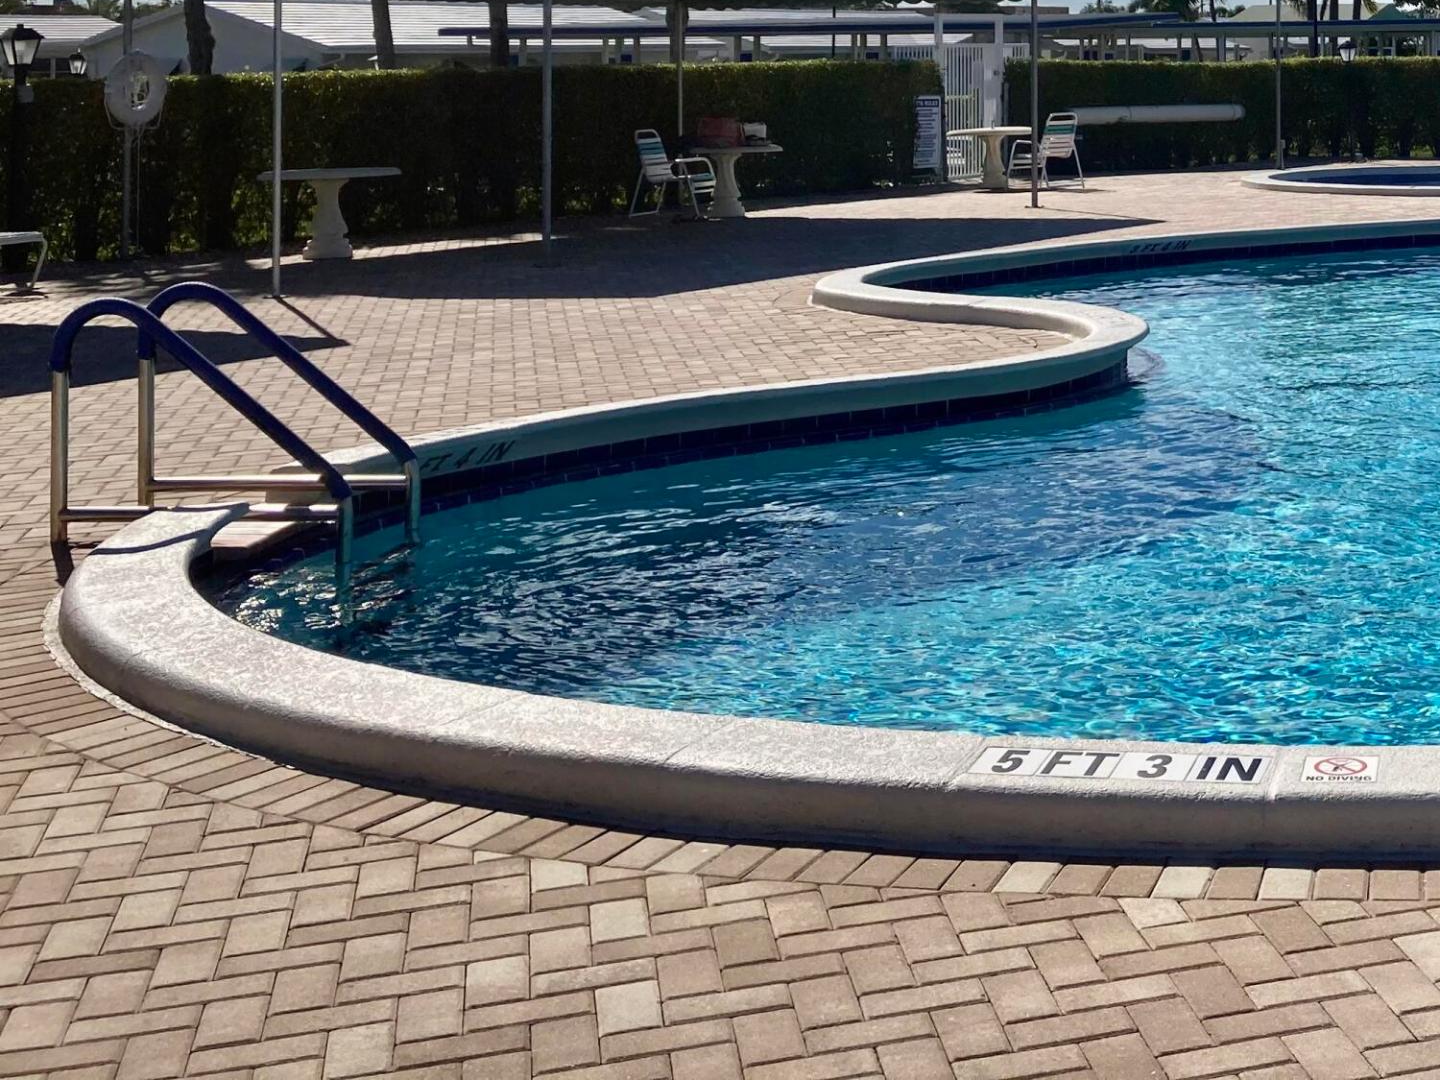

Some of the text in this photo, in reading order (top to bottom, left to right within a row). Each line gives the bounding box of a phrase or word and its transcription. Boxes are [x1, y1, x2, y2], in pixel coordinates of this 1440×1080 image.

[420, 453, 453, 471] FT
[477, 440, 516, 464] IN
[991, 750, 1263, 782] 5 FT 3 IN
